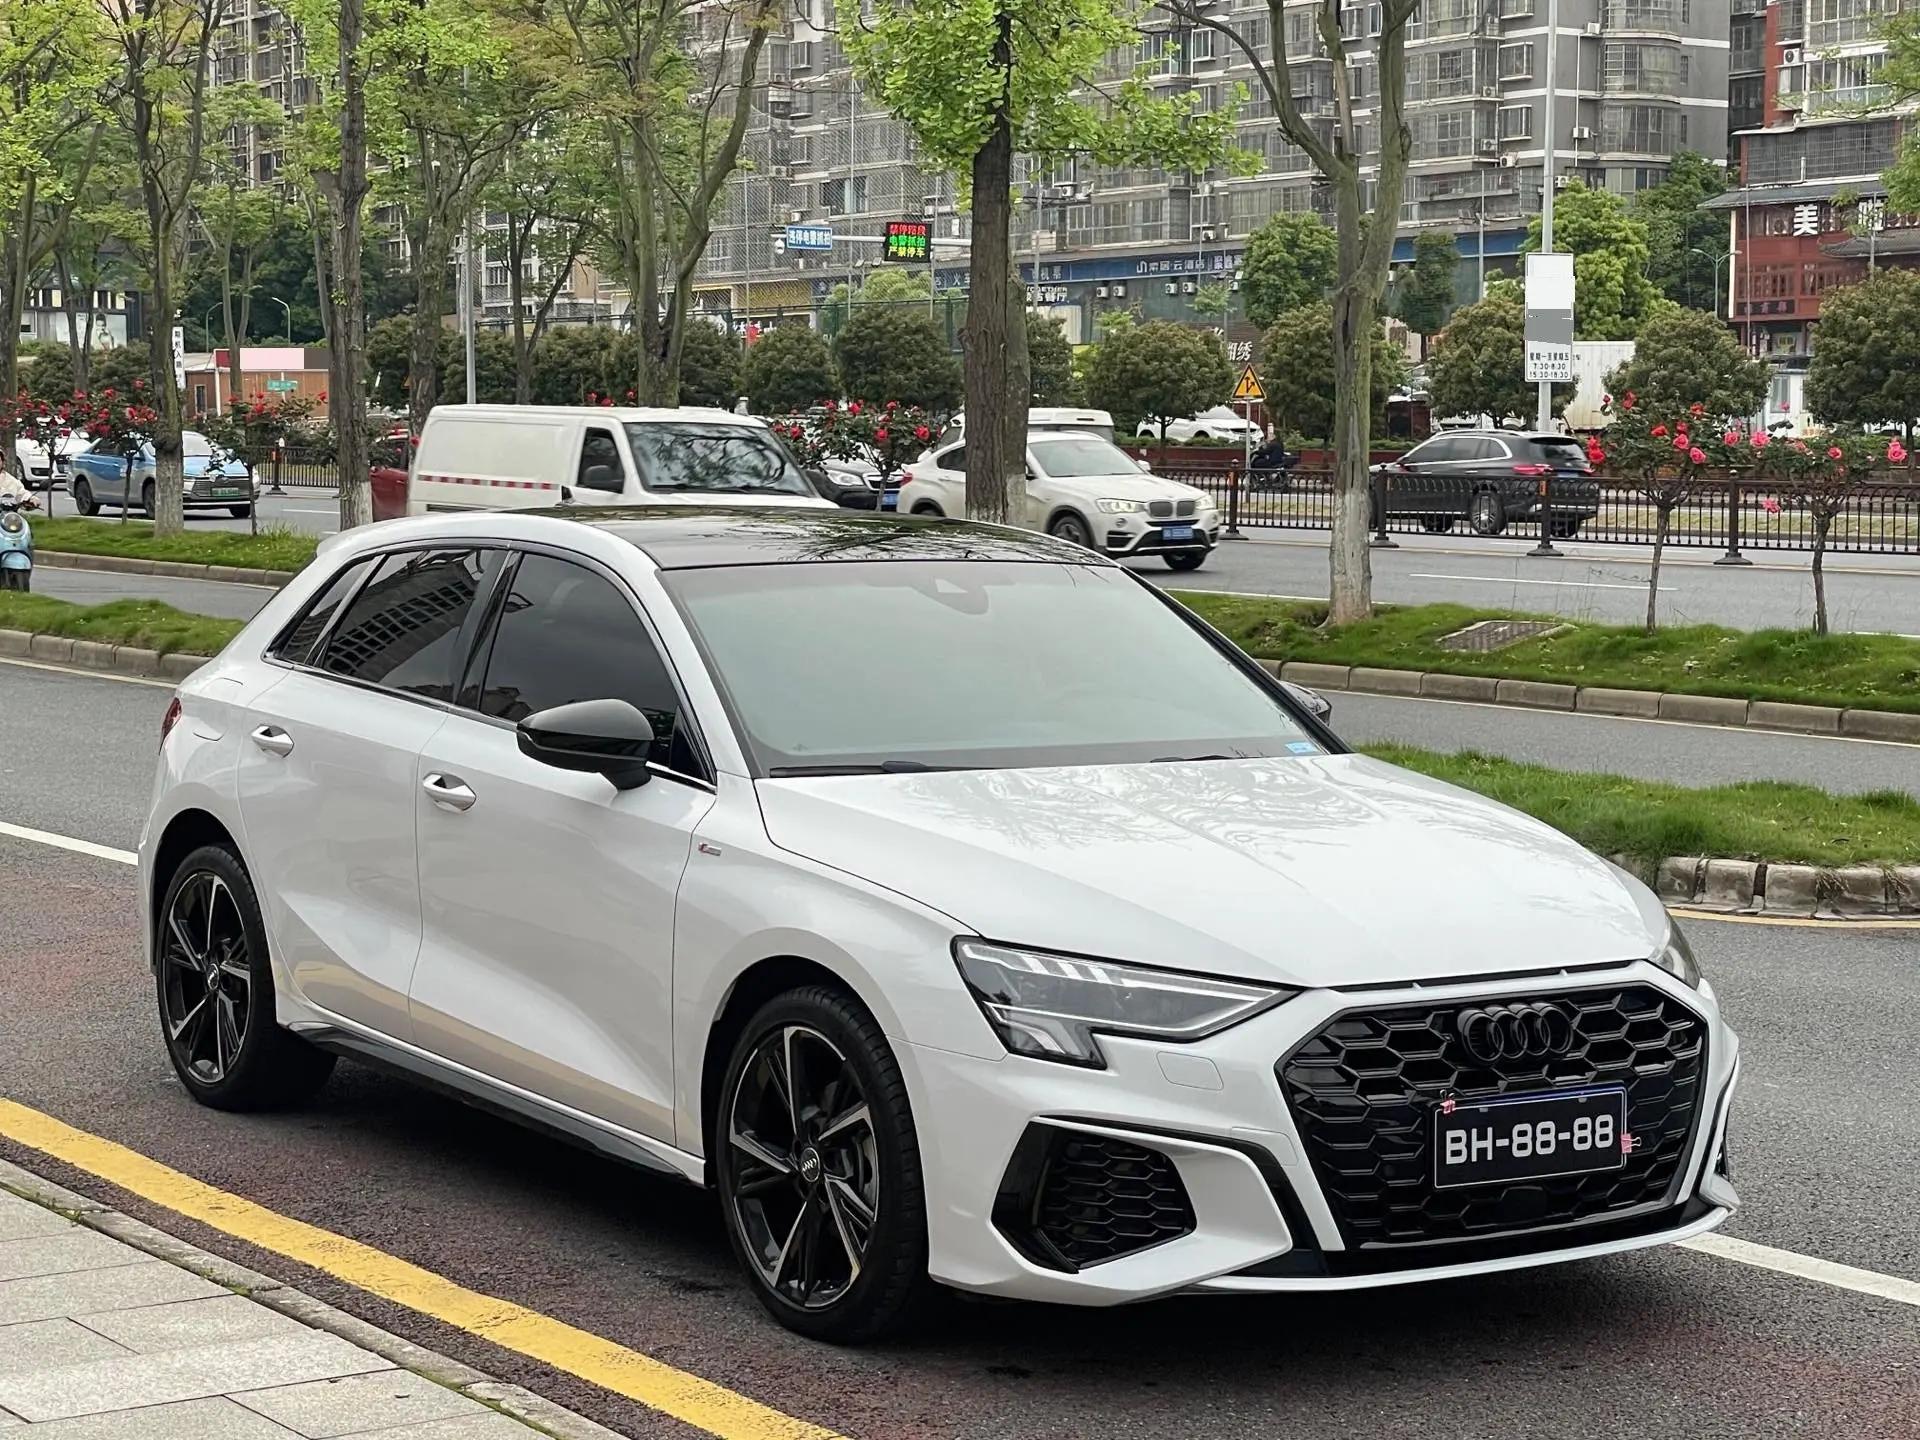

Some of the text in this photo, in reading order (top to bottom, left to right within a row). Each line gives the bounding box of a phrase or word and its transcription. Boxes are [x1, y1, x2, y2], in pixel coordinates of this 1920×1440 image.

[889, 224, 926, 236] 禁停路段
[889, 235, 926, 246] 电警抓拍
[888, 246, 926, 258] 严禁停车
[1446, 1114, 1614, 1164] BH-88-88
